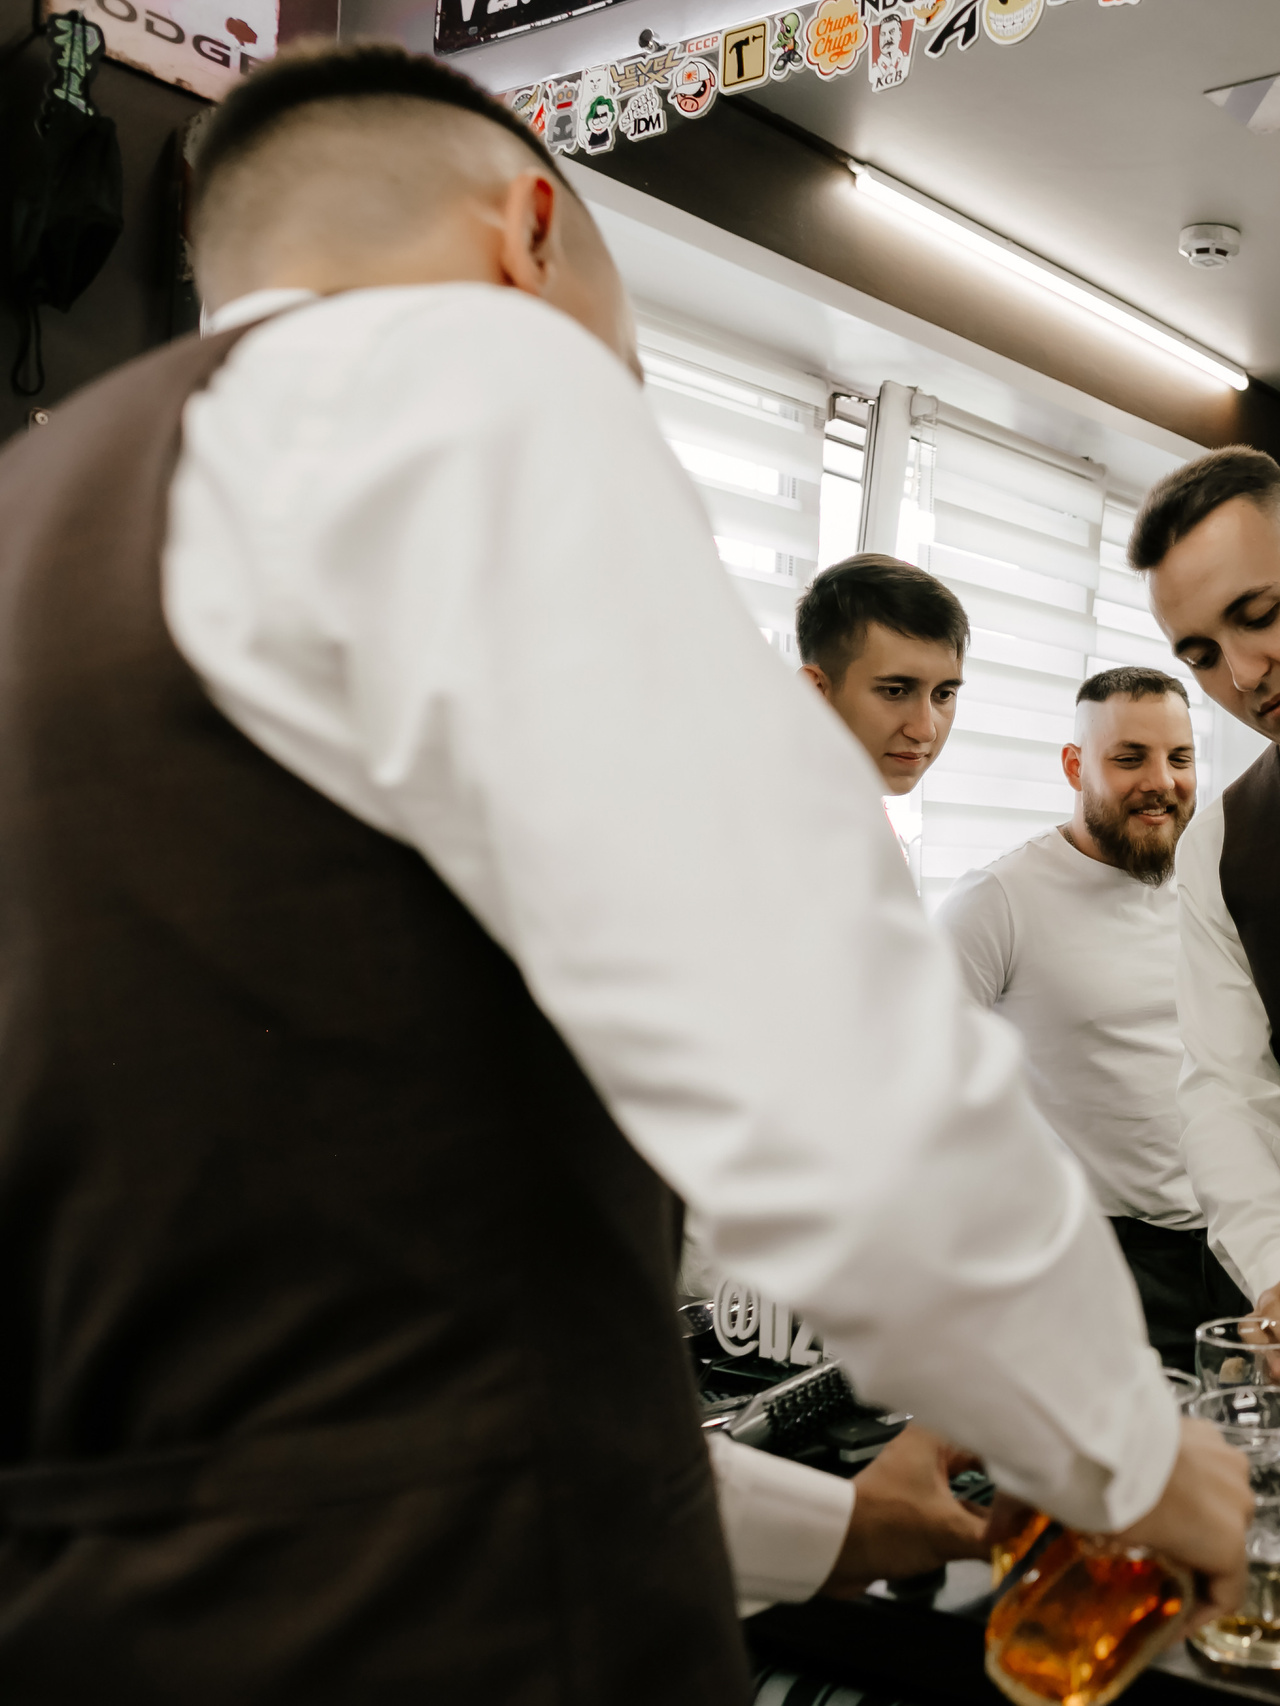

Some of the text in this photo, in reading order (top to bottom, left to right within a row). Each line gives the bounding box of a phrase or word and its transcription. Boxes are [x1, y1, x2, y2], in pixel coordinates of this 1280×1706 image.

[816, 11, 858, 37] Chupa
[813, 29, 858, 62] Chups
[610, 47, 686, 83] LEVEL
[617, 68, 673, 94] SIX
[876, 70, 902, 89] KGB
[630, 113, 661, 137] JDM
